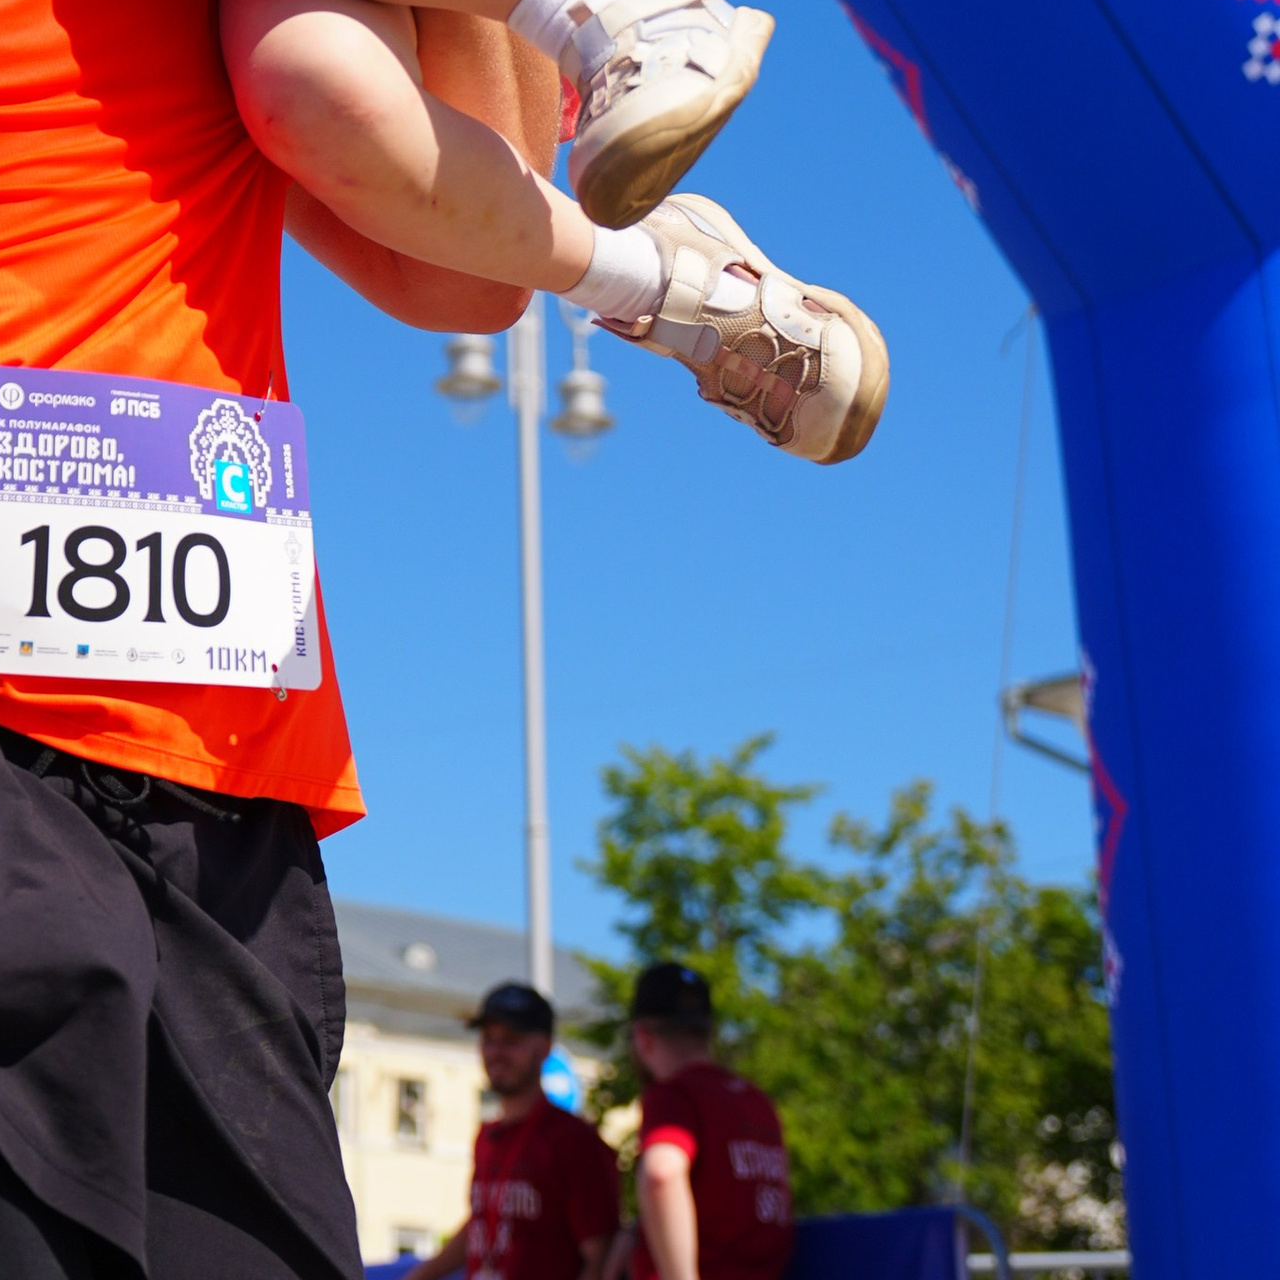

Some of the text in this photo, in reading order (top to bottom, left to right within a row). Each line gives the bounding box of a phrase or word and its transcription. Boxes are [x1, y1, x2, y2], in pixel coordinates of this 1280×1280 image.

[28, 392, 96, 408] фармэко
[127, 399, 161, 419] ПСБ
[9, 419, 101, 434] ПОЛУМАРАФОН
[20, 524, 232, 628] 1810
